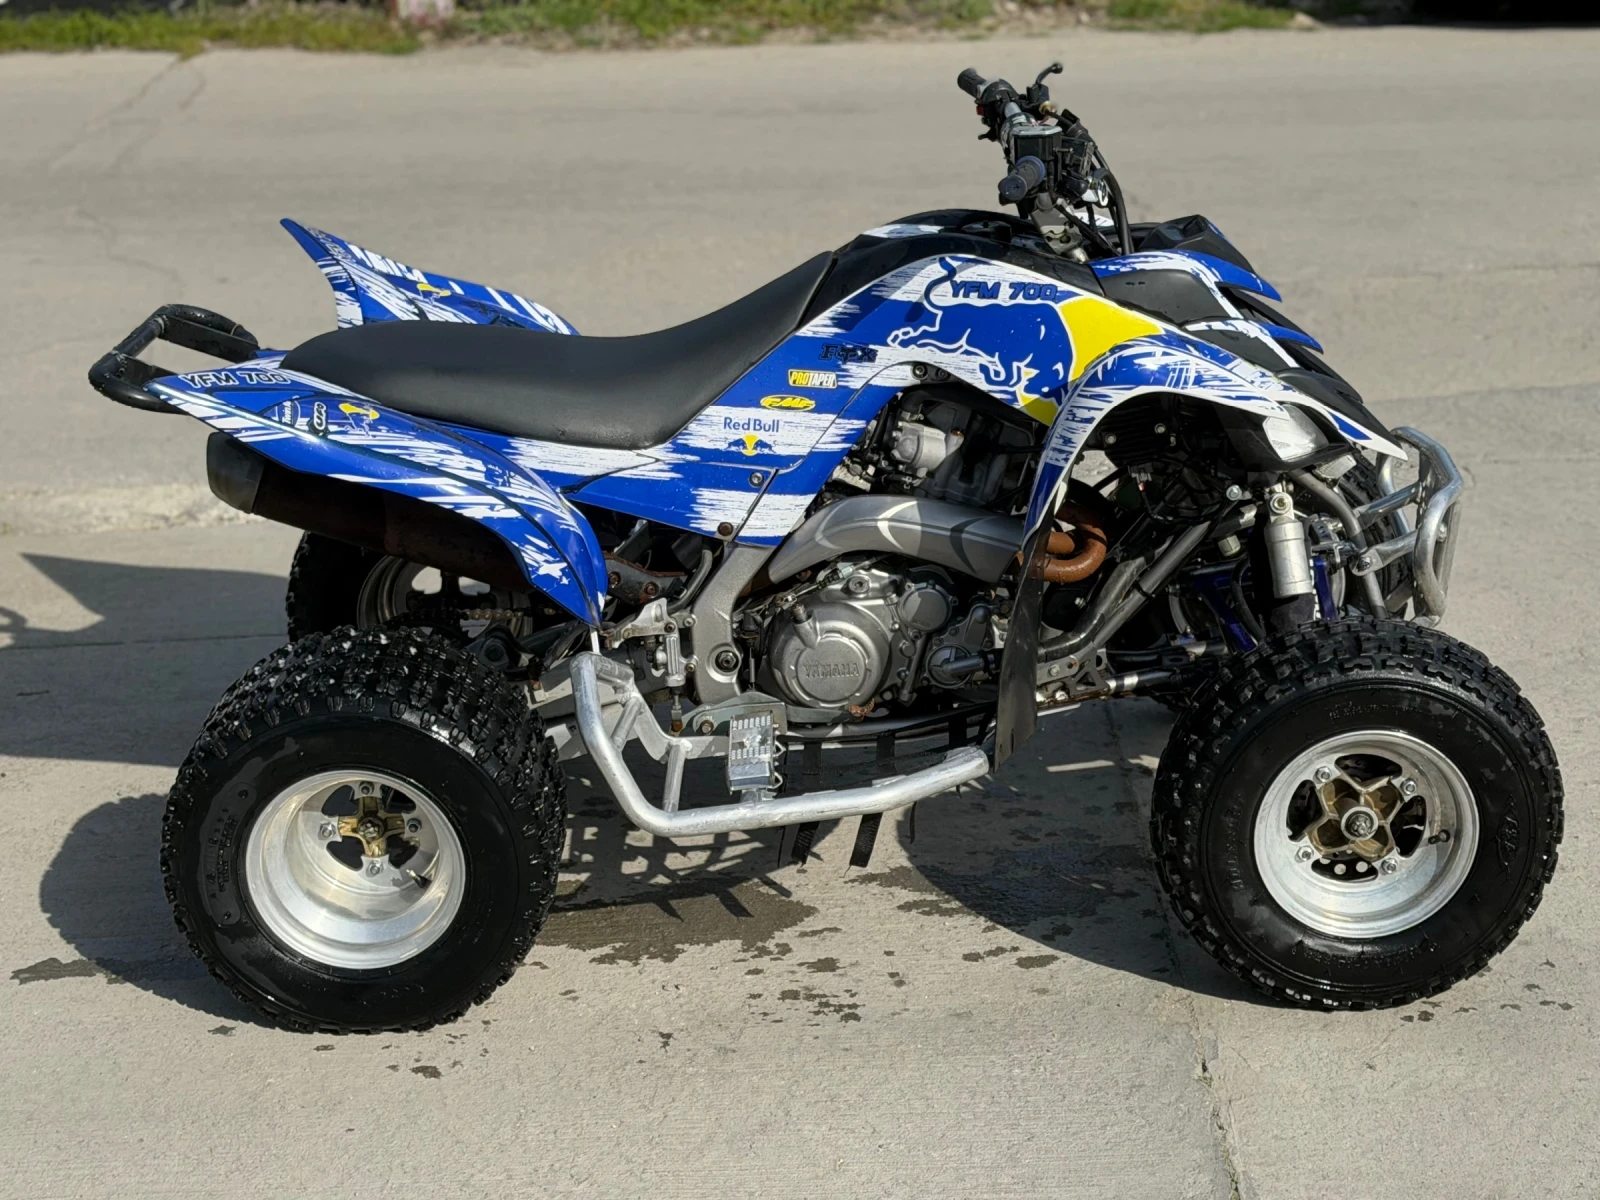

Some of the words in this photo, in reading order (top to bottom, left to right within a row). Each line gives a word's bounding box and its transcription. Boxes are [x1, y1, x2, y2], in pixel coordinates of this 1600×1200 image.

[950, 280, 1001, 300] YFM
[1009, 282, 1058, 301] 700
[178, 371, 239, 389] YFM
[236, 371, 291, 385] 700
[723, 417, 751, 431] Red
[752, 418, 780, 433] Bull
[803, 662, 861, 679] YAMAHA
